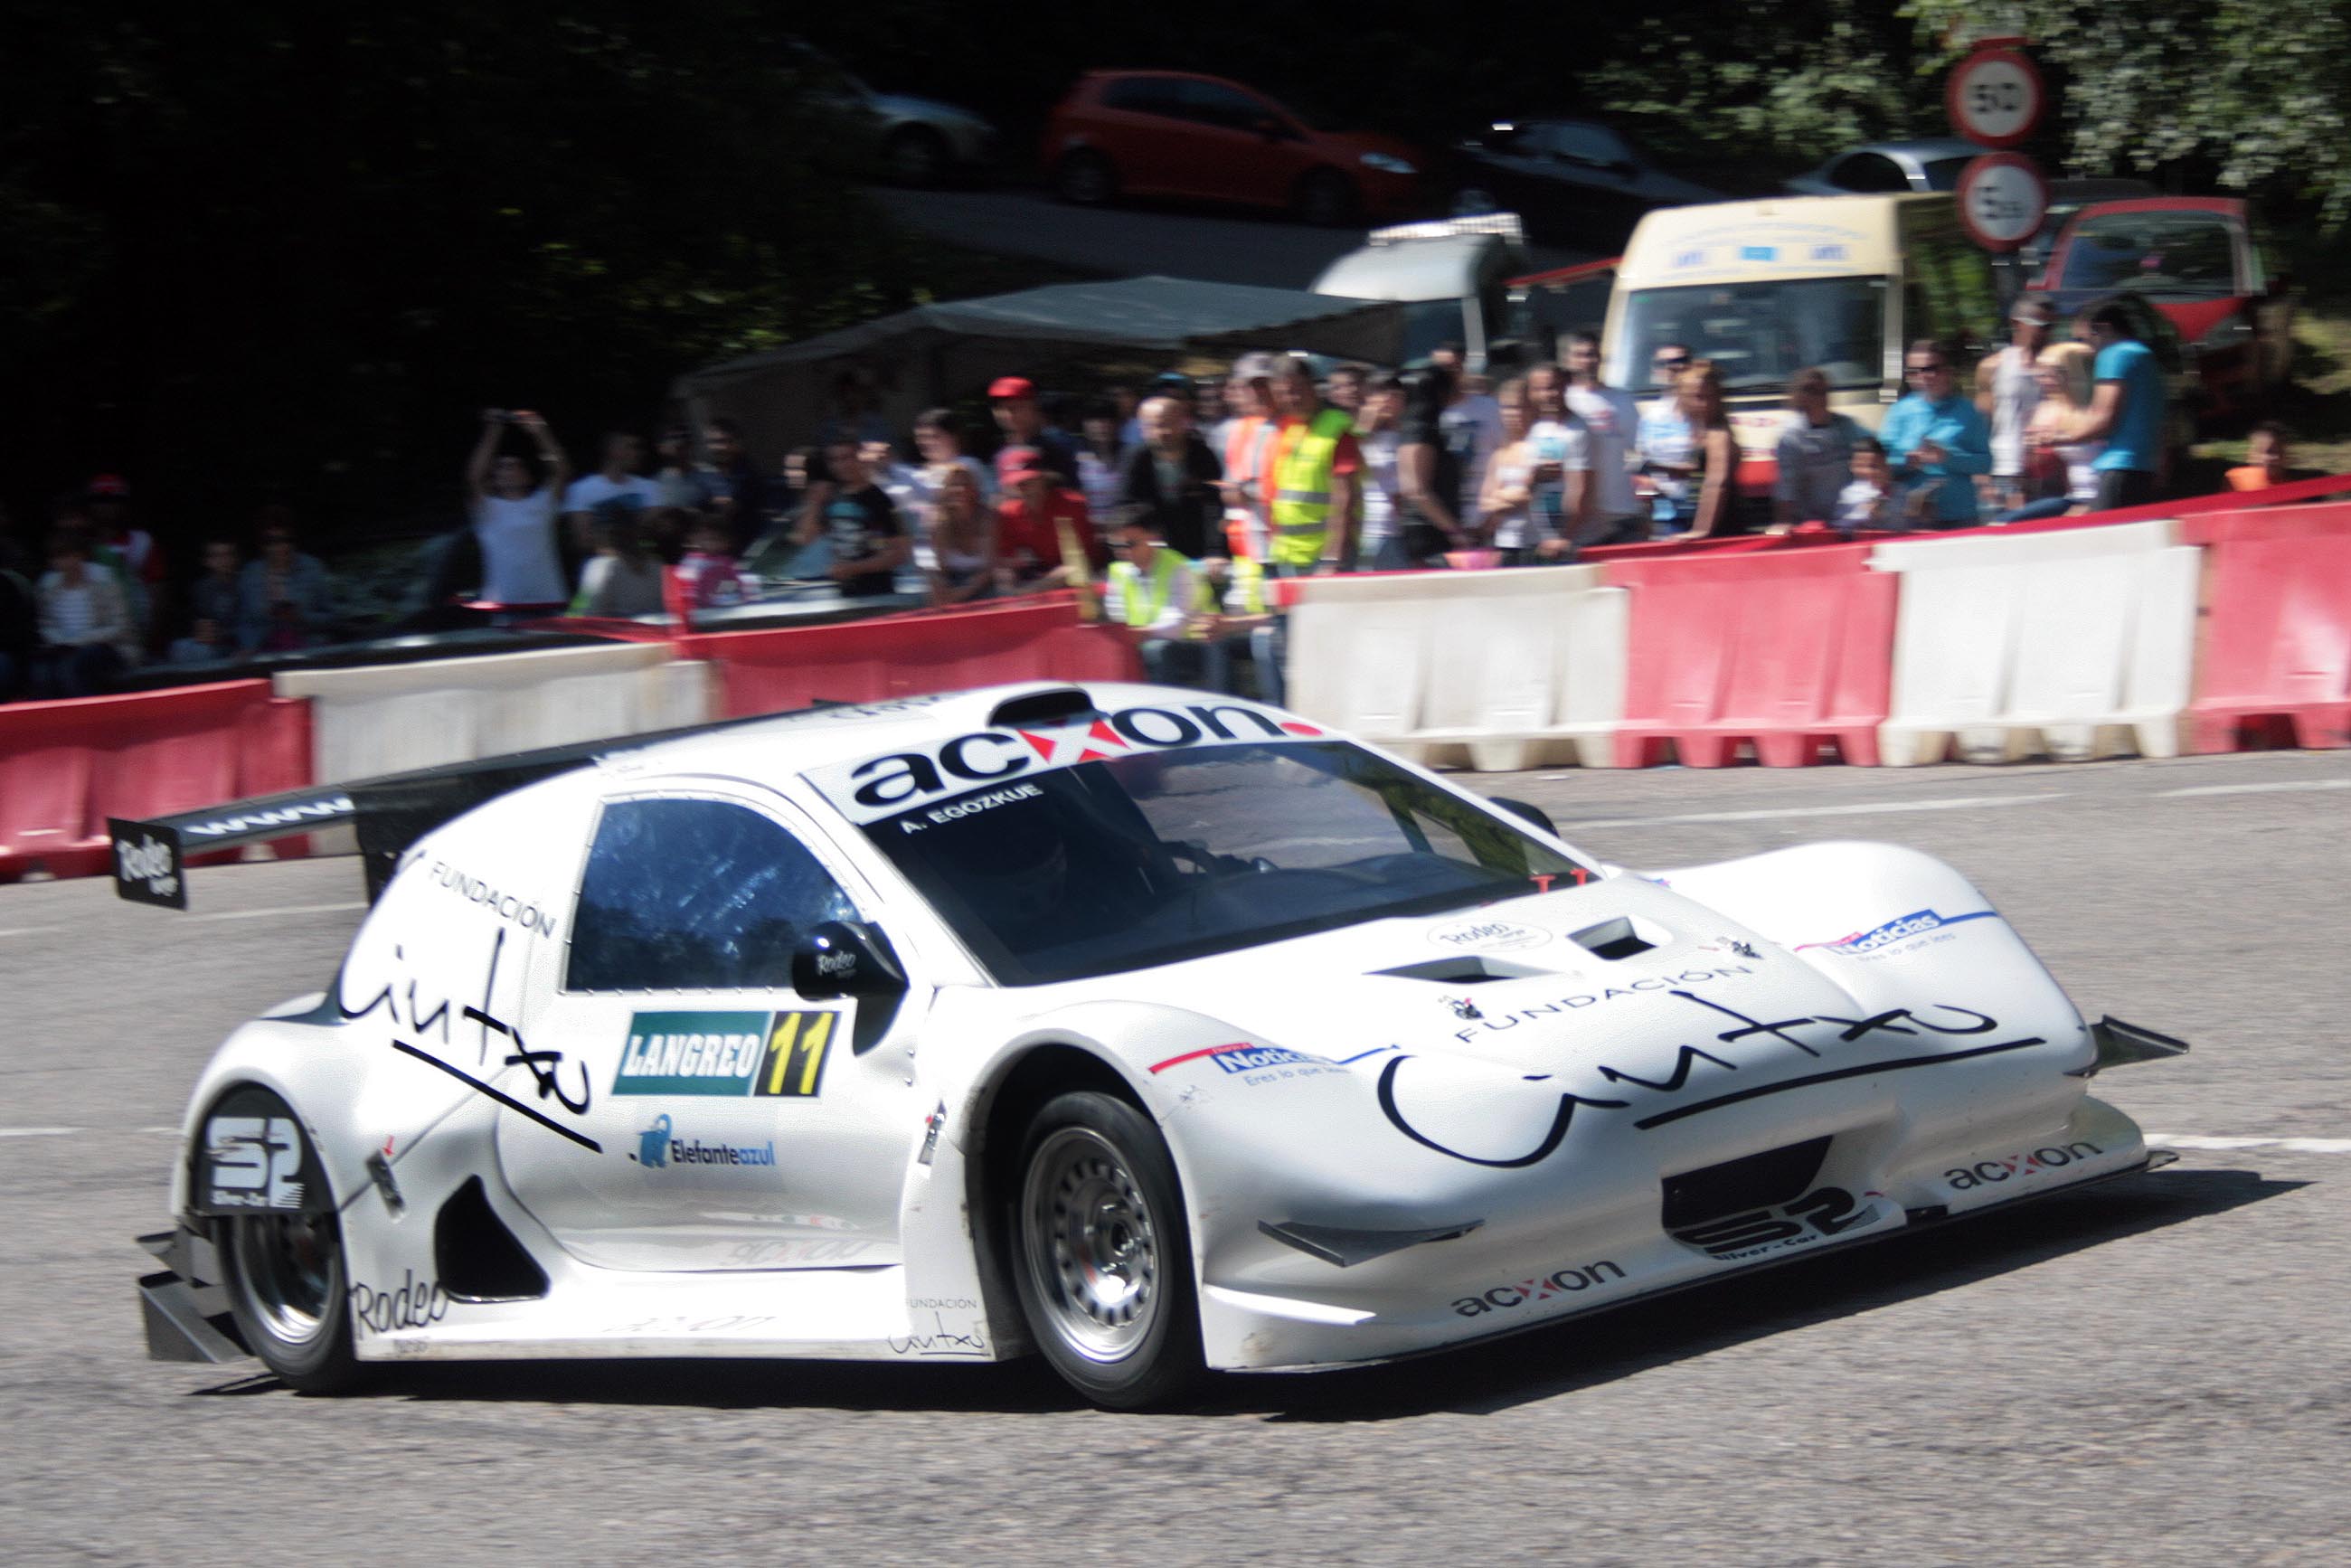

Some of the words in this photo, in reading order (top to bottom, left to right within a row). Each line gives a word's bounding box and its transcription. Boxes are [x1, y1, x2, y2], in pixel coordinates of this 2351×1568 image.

[928, 782, 1044, 825] EGOZKUE
[429, 860, 557, 940] FUNDACIÓN
[817, 950, 856, 976] Rodeo
[1454, 965, 1752, 1044] FUNDACIÓN
[621, 1033, 761, 1078] LANGREO
[770, 1011, 835, 1095] 11
[346, 1268, 449, 1342] Rodeo
